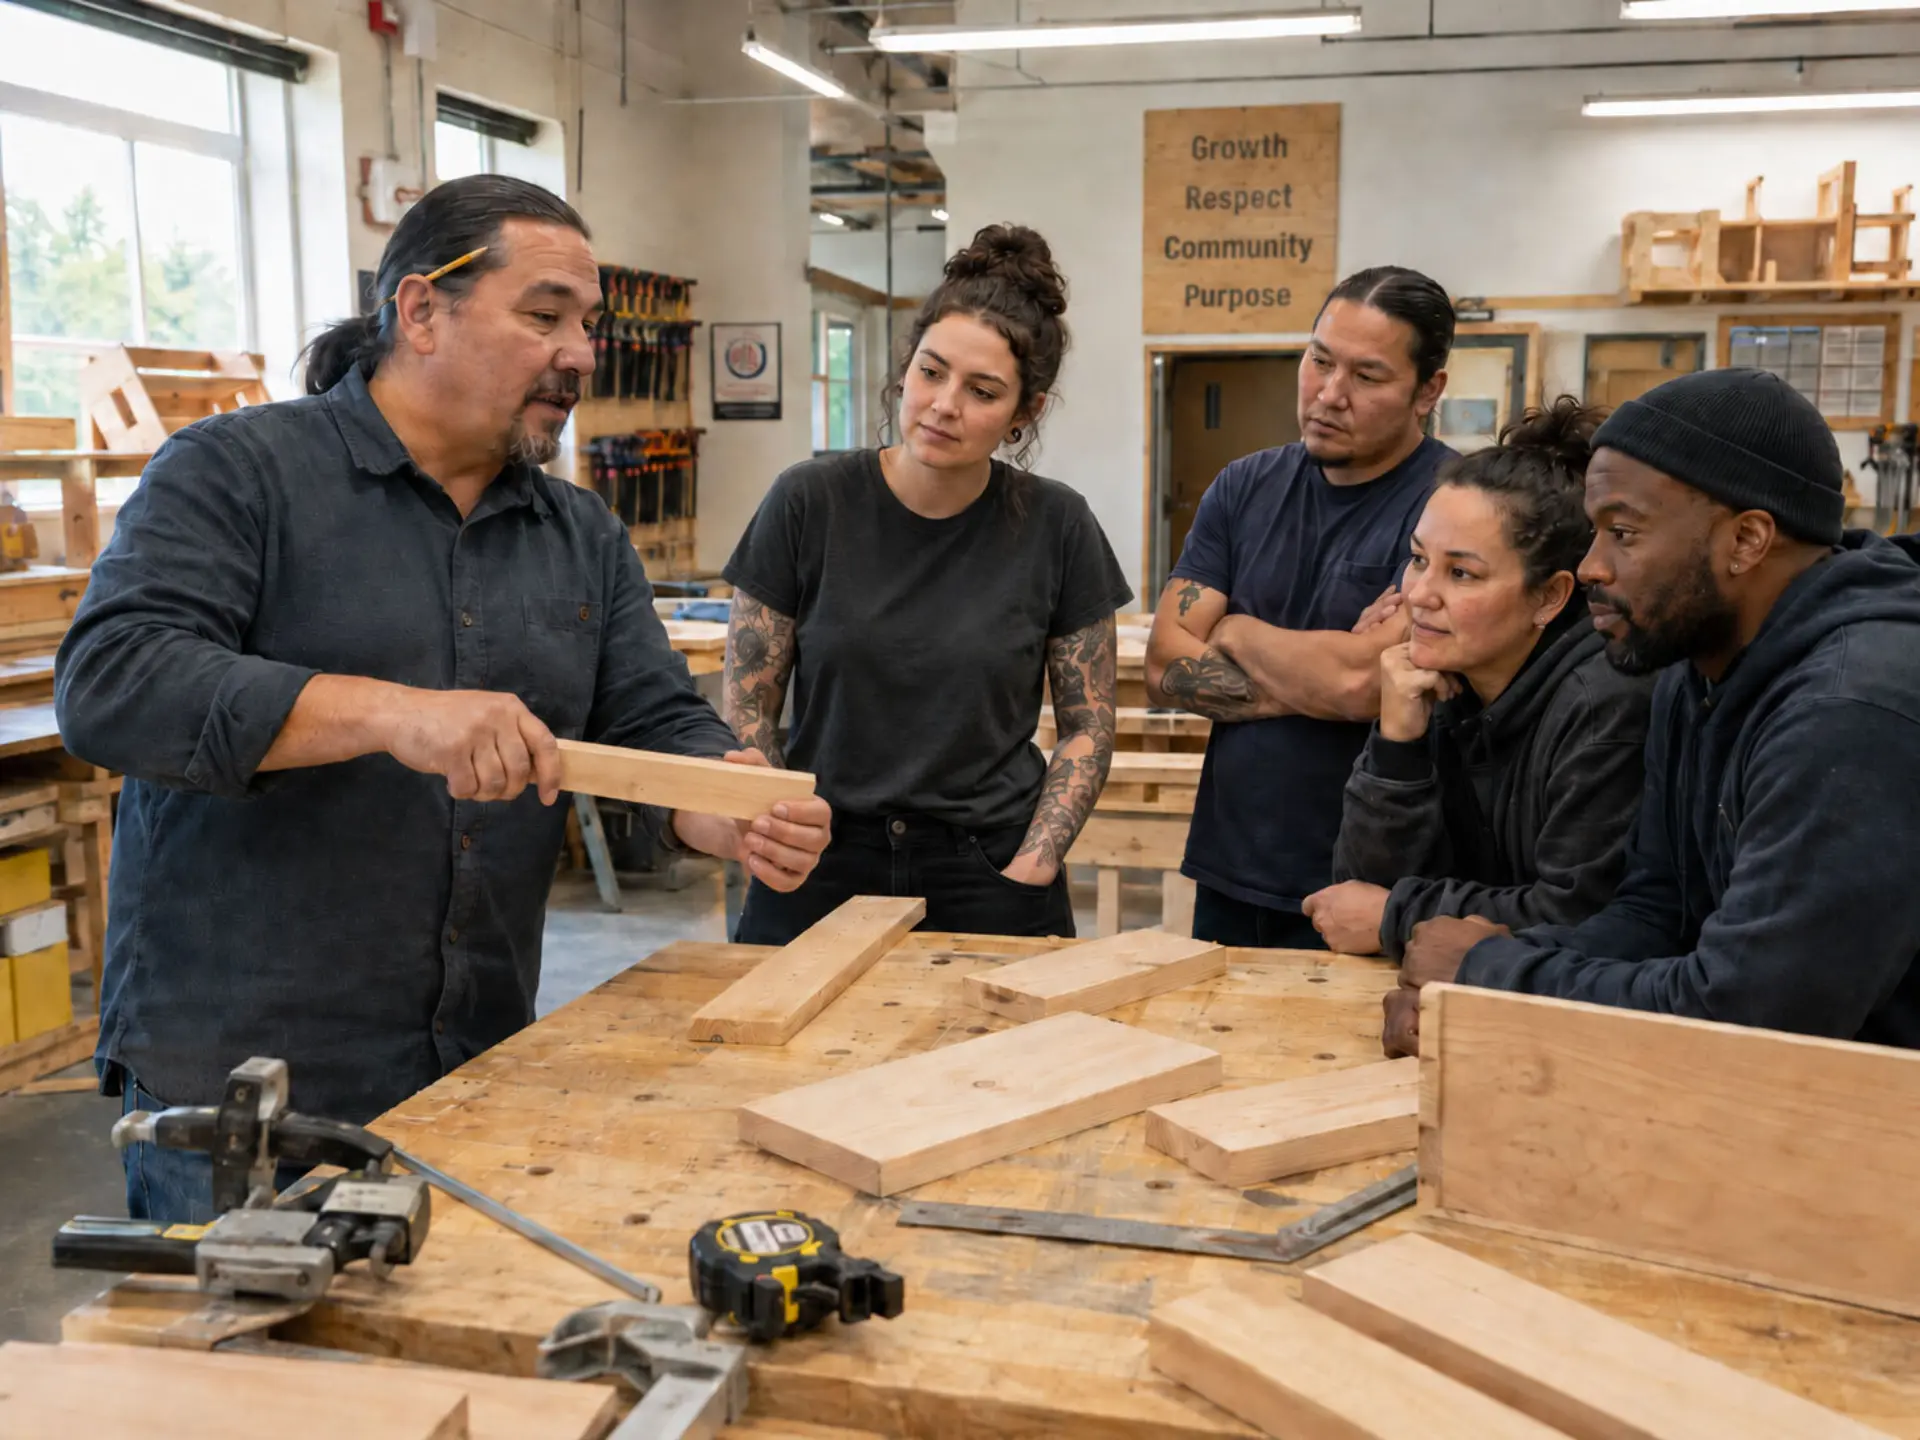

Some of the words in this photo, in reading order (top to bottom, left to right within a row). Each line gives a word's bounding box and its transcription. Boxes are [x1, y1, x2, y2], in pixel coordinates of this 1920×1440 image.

[1191, 132, 1289, 160] Growth
[1185, 184, 1293, 216] Respect
[1164, 232, 1313, 263] Community
[1184, 284, 1292, 313] Purpose
